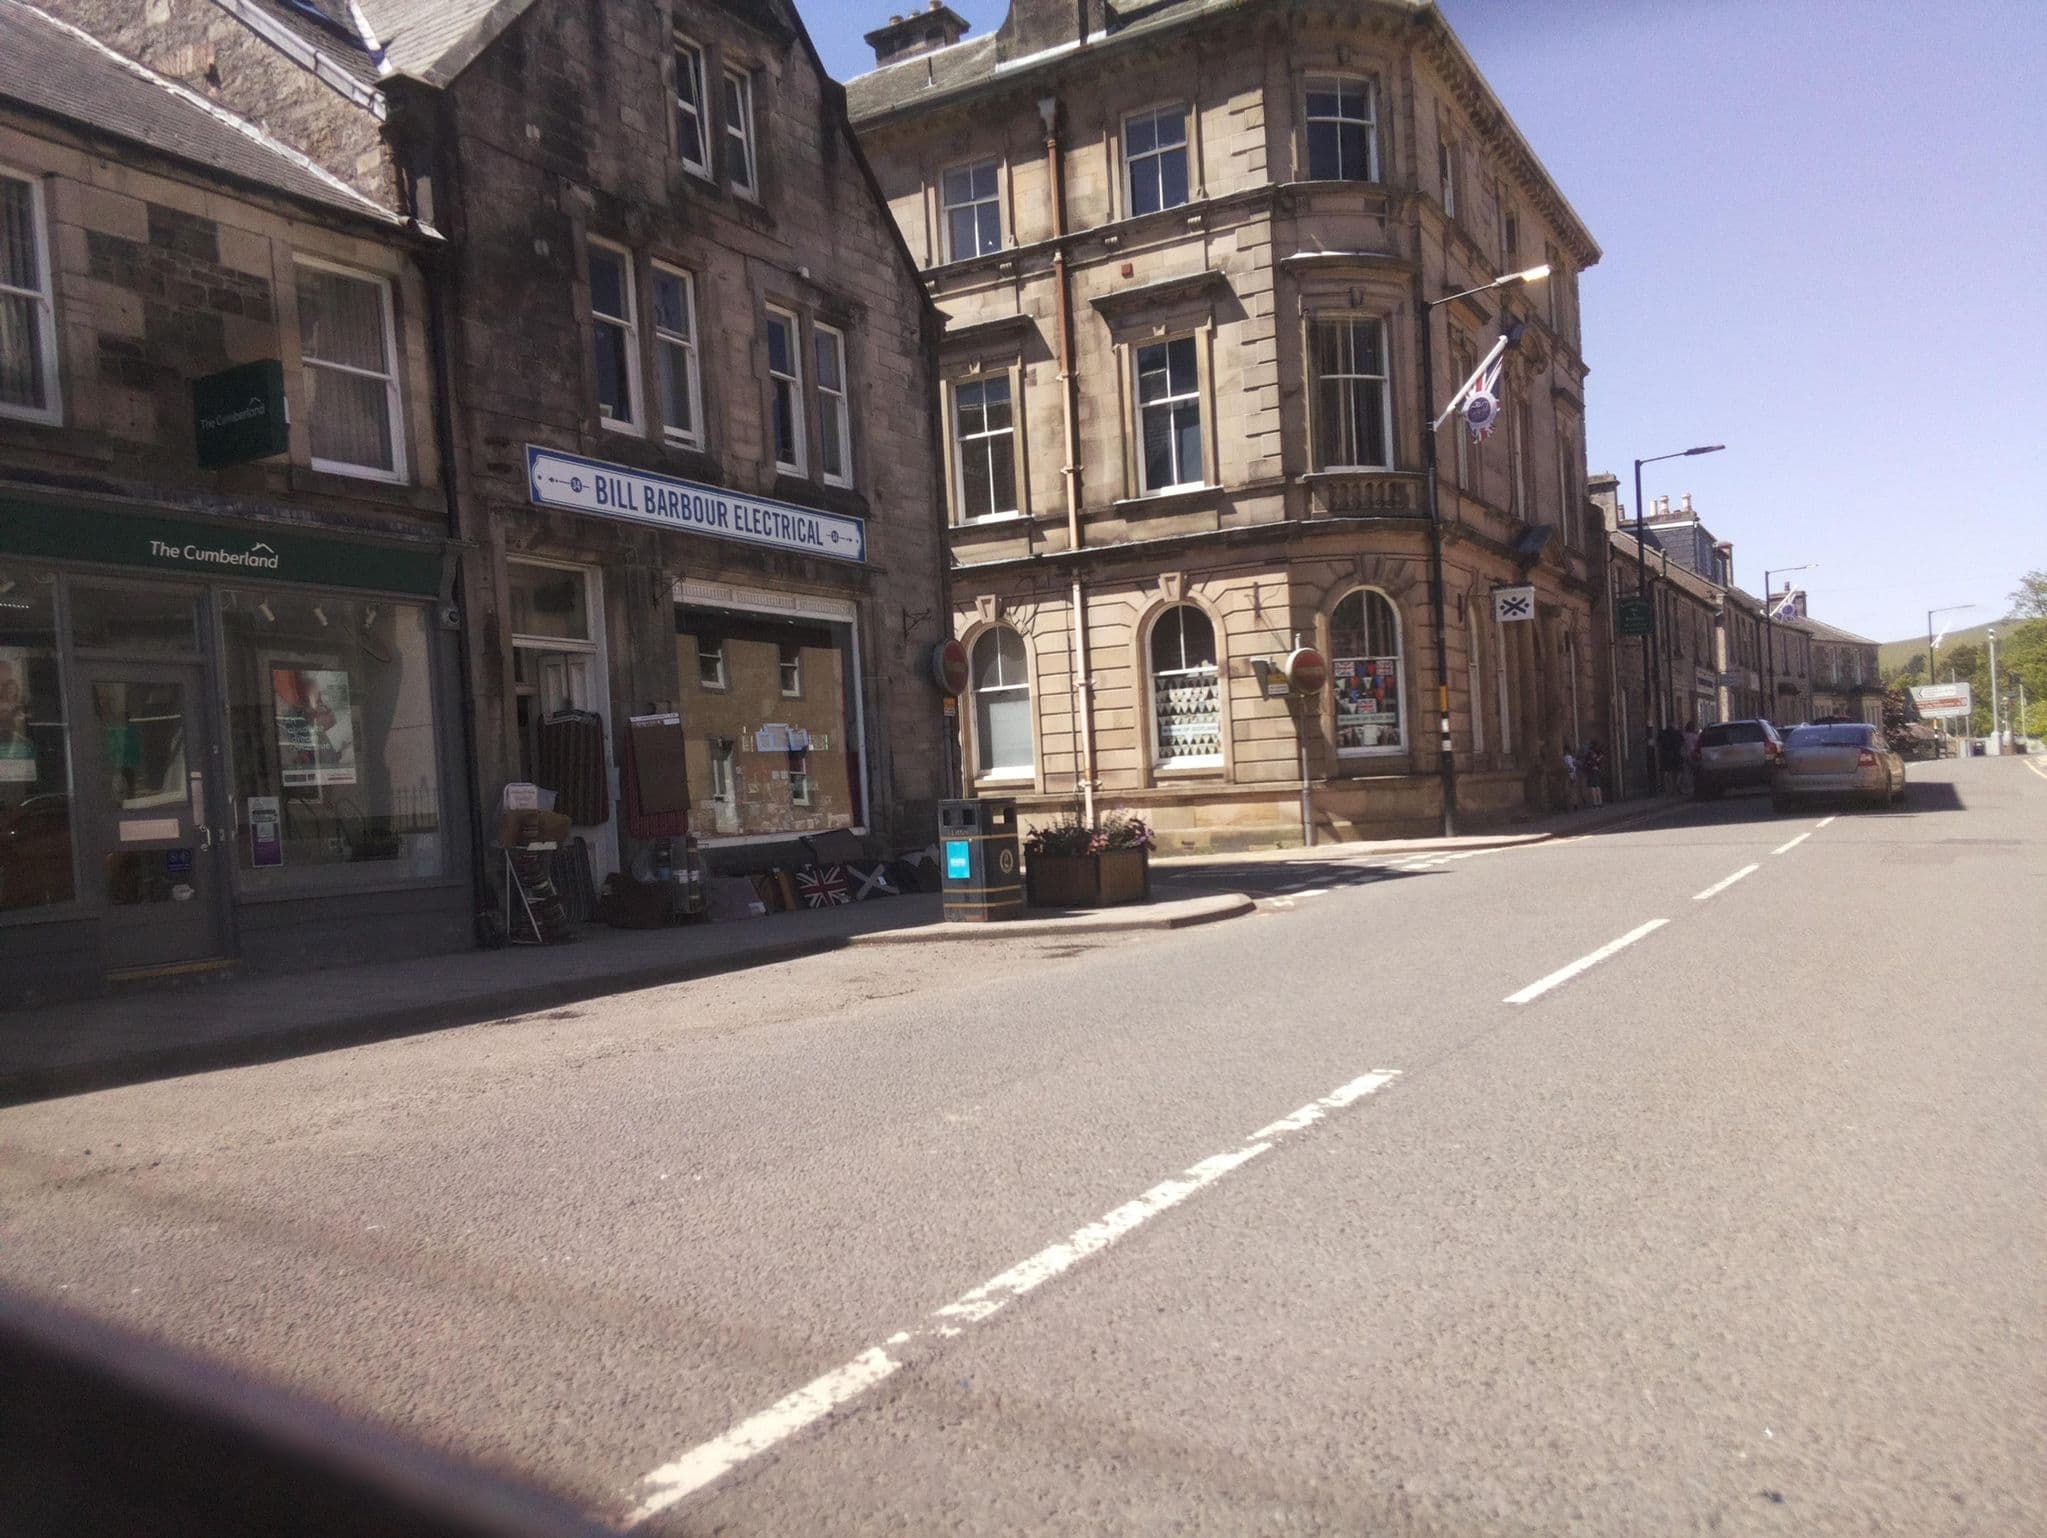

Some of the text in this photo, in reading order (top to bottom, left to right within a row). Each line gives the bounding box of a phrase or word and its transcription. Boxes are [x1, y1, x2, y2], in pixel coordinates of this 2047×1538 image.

[595, 475, 638, 511] BILL
[644, 485, 728, 529] BARBOUR
[734, 504, 823, 546] ELECTRICAL
[150, 540, 279, 569] The Cumberland
